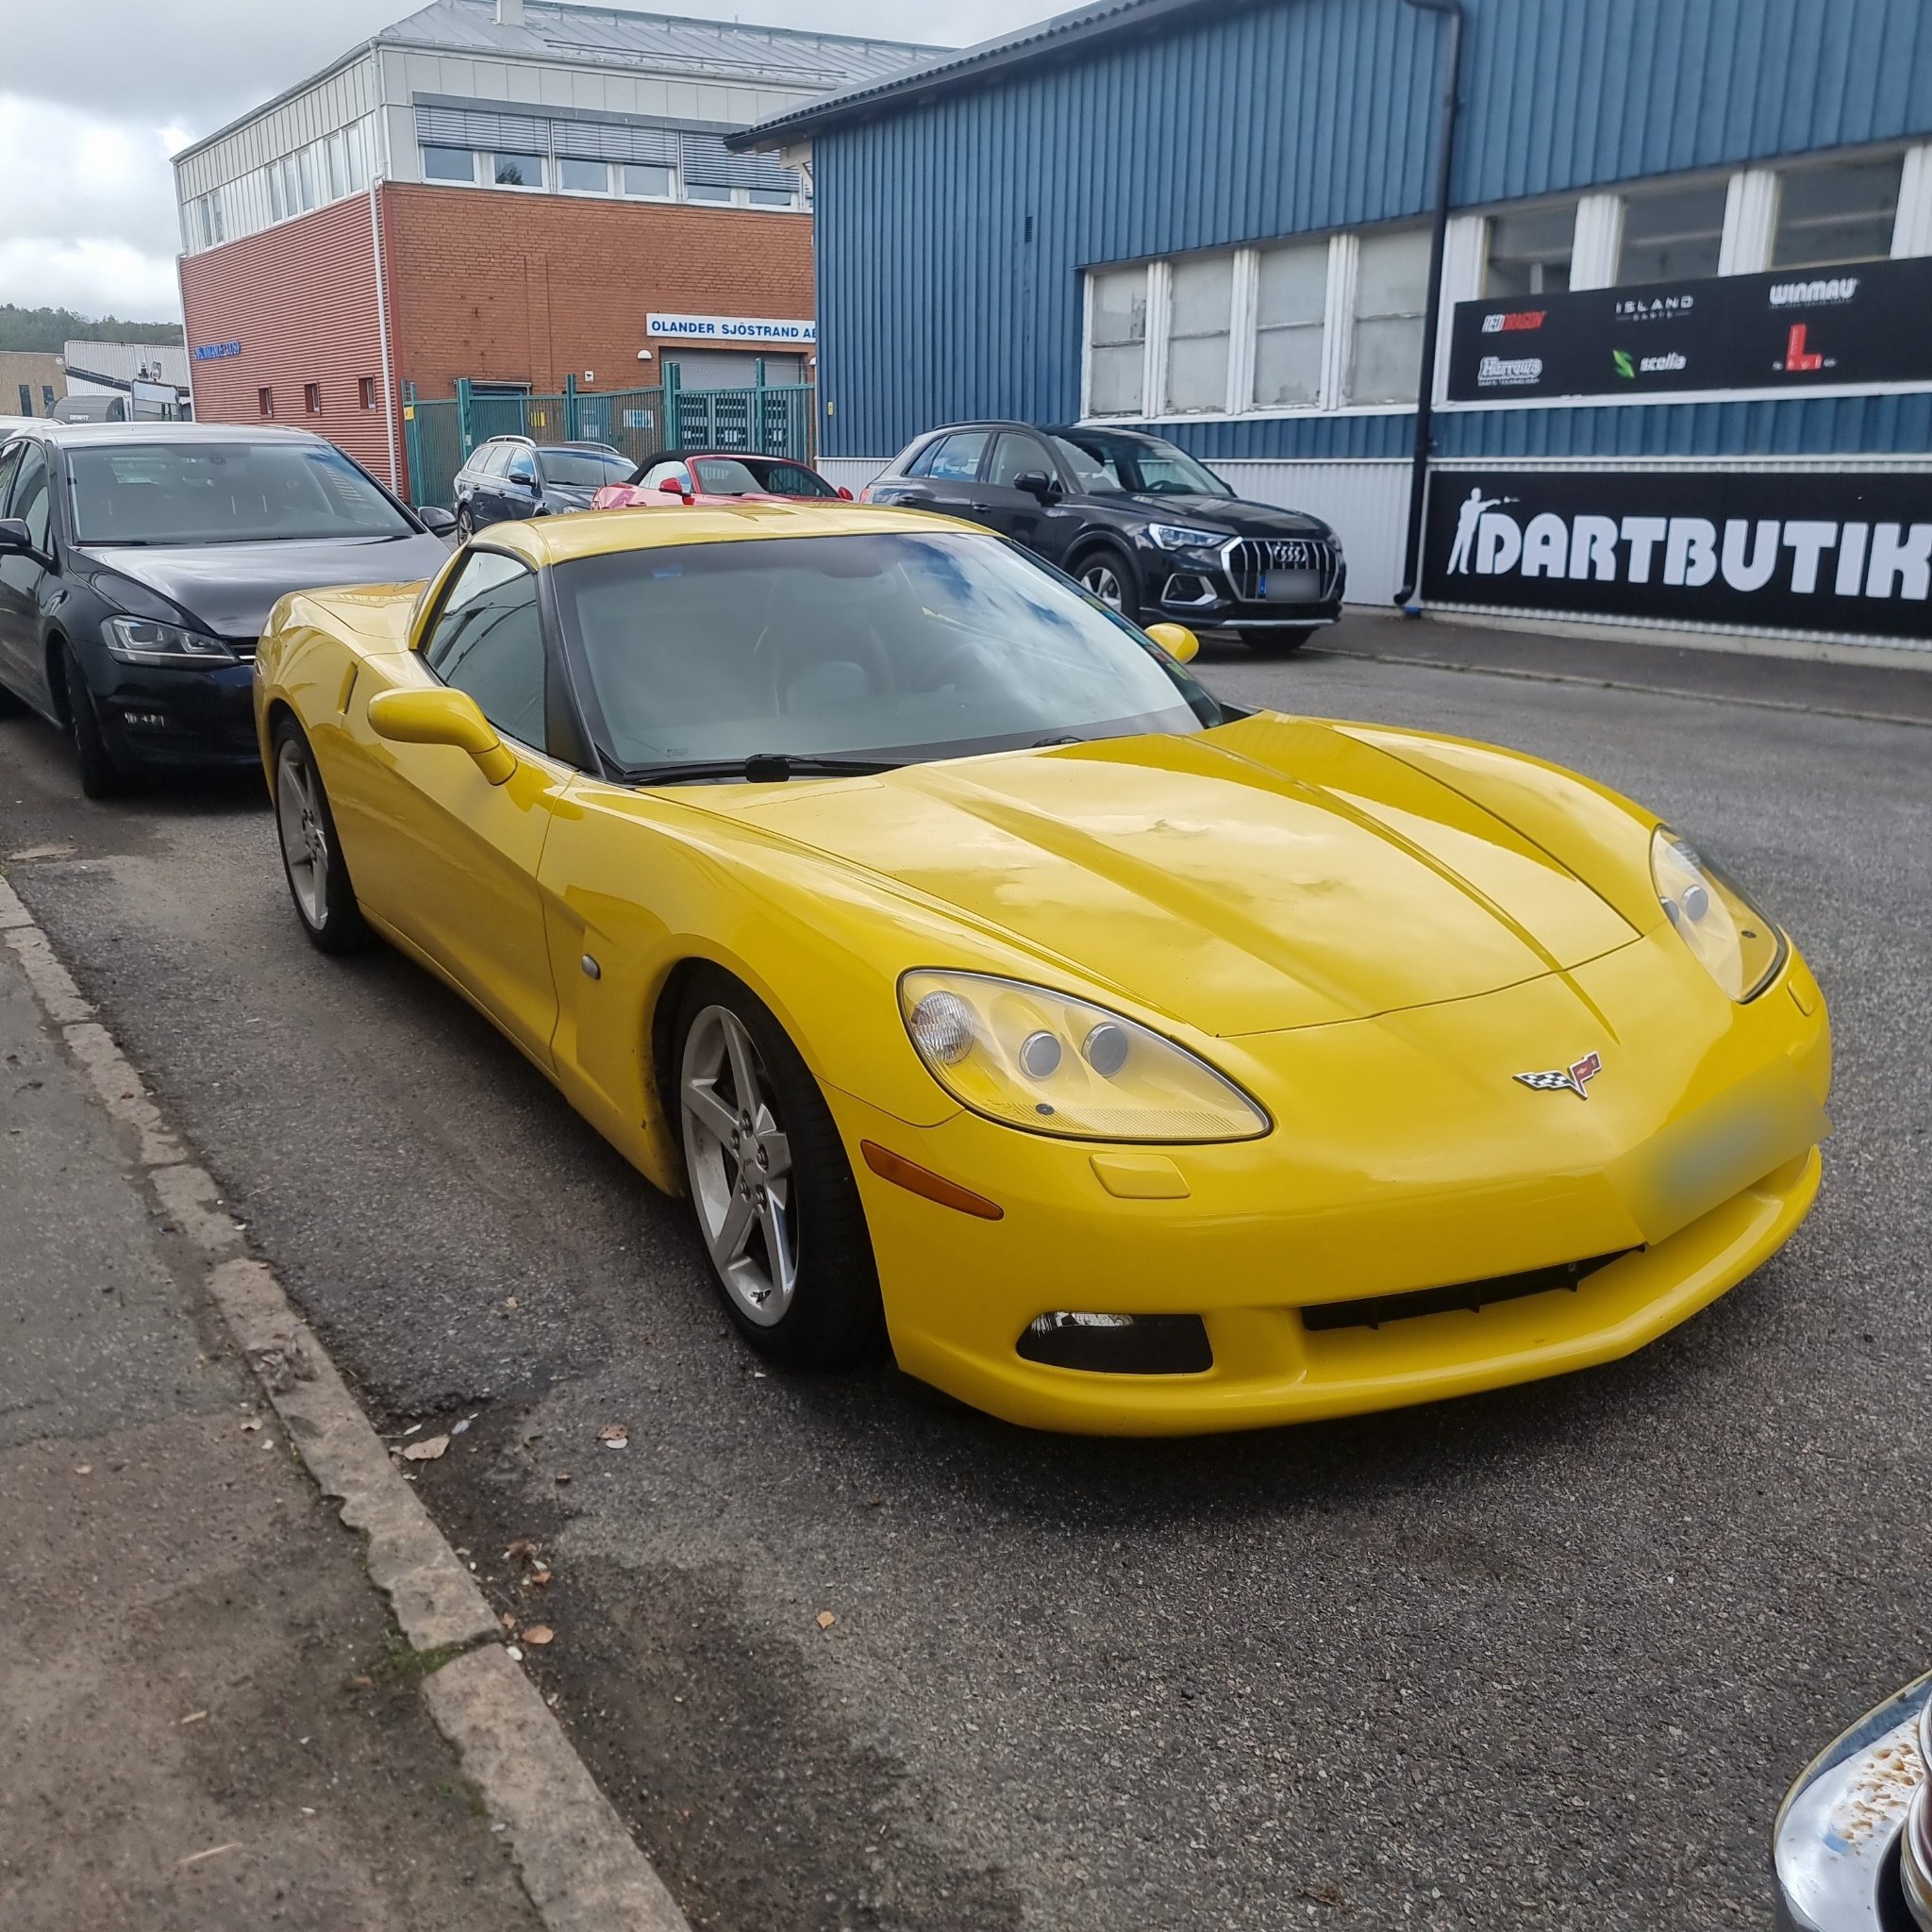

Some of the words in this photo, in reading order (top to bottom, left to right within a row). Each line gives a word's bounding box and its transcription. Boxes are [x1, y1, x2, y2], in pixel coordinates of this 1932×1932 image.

[1770, 277, 1857, 305] WINMAU
[1616, 295, 1693, 314] ISLAND
[652, 320, 715, 334] OLANDER
[722, 322, 799, 338] SJÖSTRAND
[1476, 512, 1932, 601] DARTBUTIK
